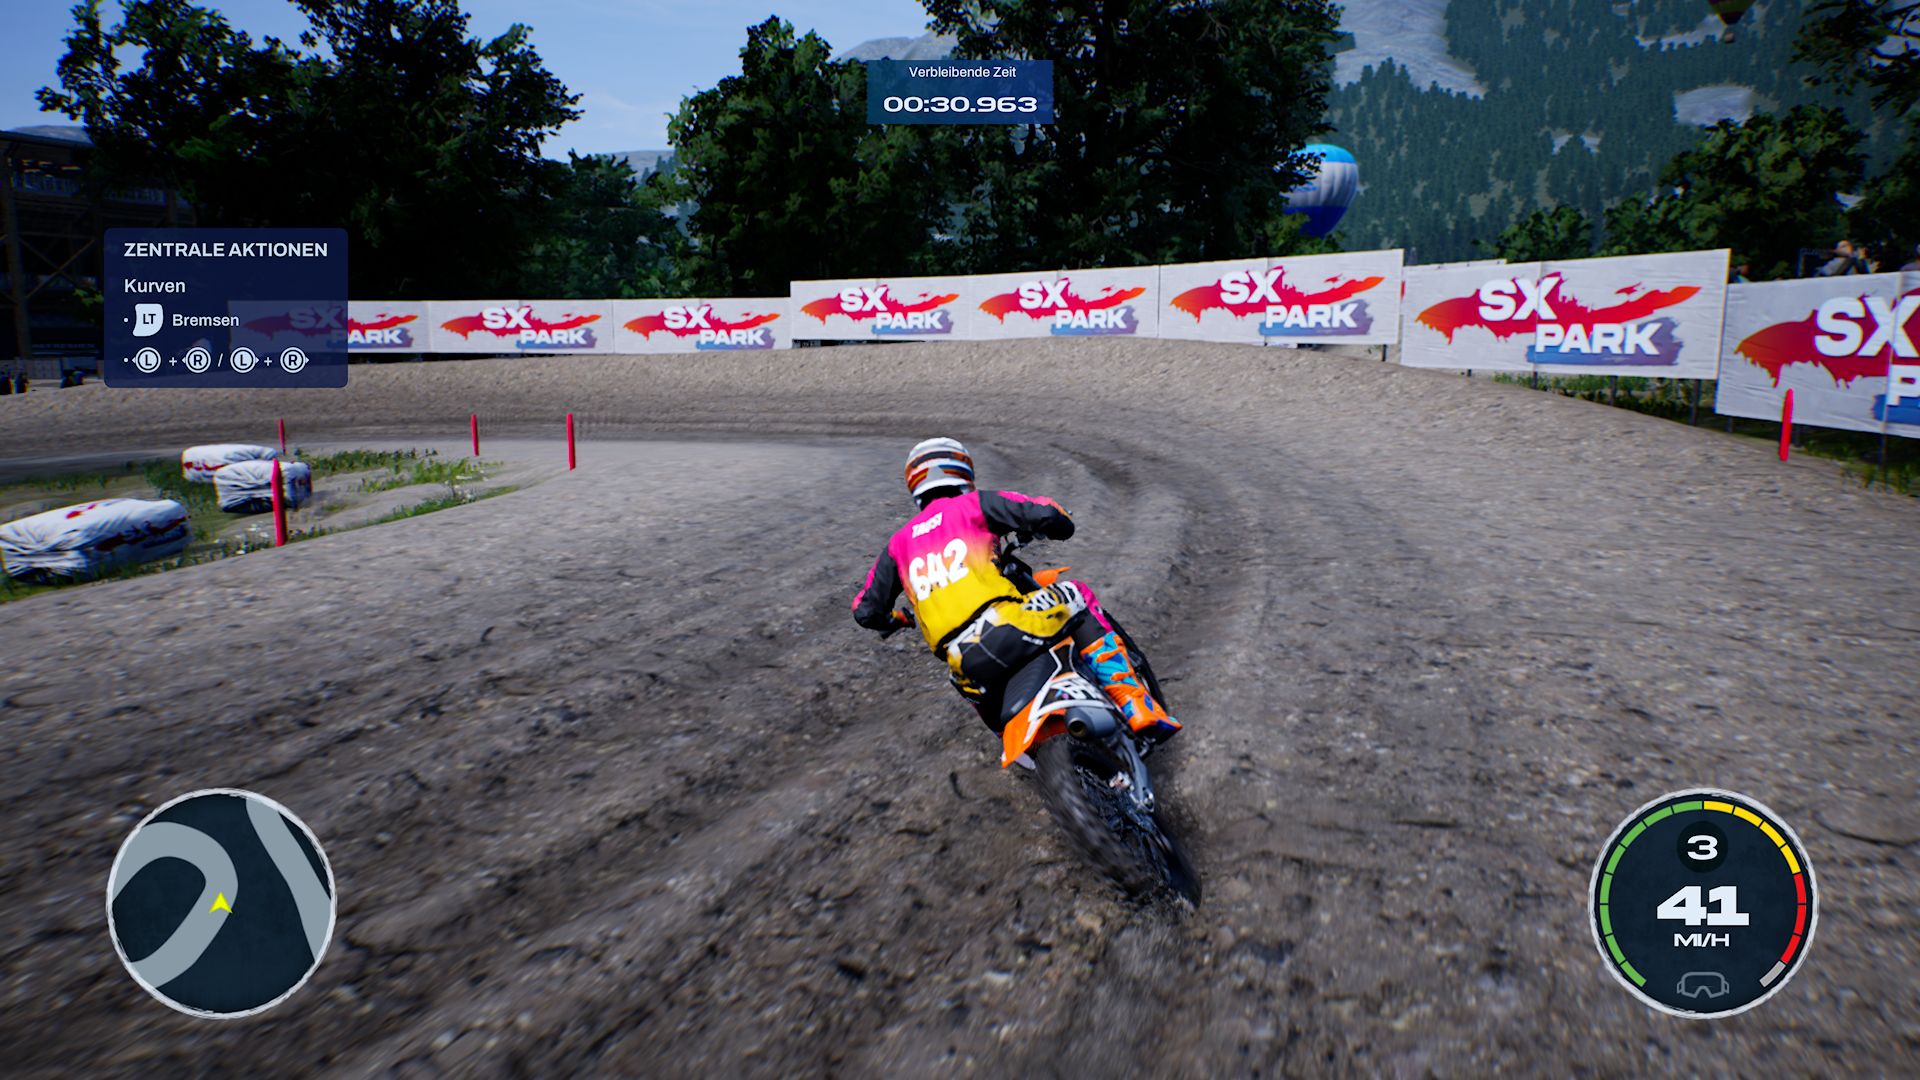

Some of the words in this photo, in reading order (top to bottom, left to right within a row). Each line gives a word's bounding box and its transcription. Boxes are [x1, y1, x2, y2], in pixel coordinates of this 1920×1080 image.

[839, 285, 889, 312] SX
[1019, 279, 1071, 310] SX
[1220, 269, 1284, 304] SX
[1478, 276, 1558, 321] SX
[482, 306, 533, 330] SX
[663, 305, 711, 330] SX
[875, 310, 944, 330] PARK
[1055, 307, 1127, 329] PARK
[1265, 304, 1357, 328] PARK
[1814, 295, 1920, 358] SX
[520, 329, 588, 346] PARK
[700, 329, 766, 346] PARK
[1534, 322, 1662, 355] PARK
[1886, 363, 1920, 407] P
[909, 538, 968, 600] 642
